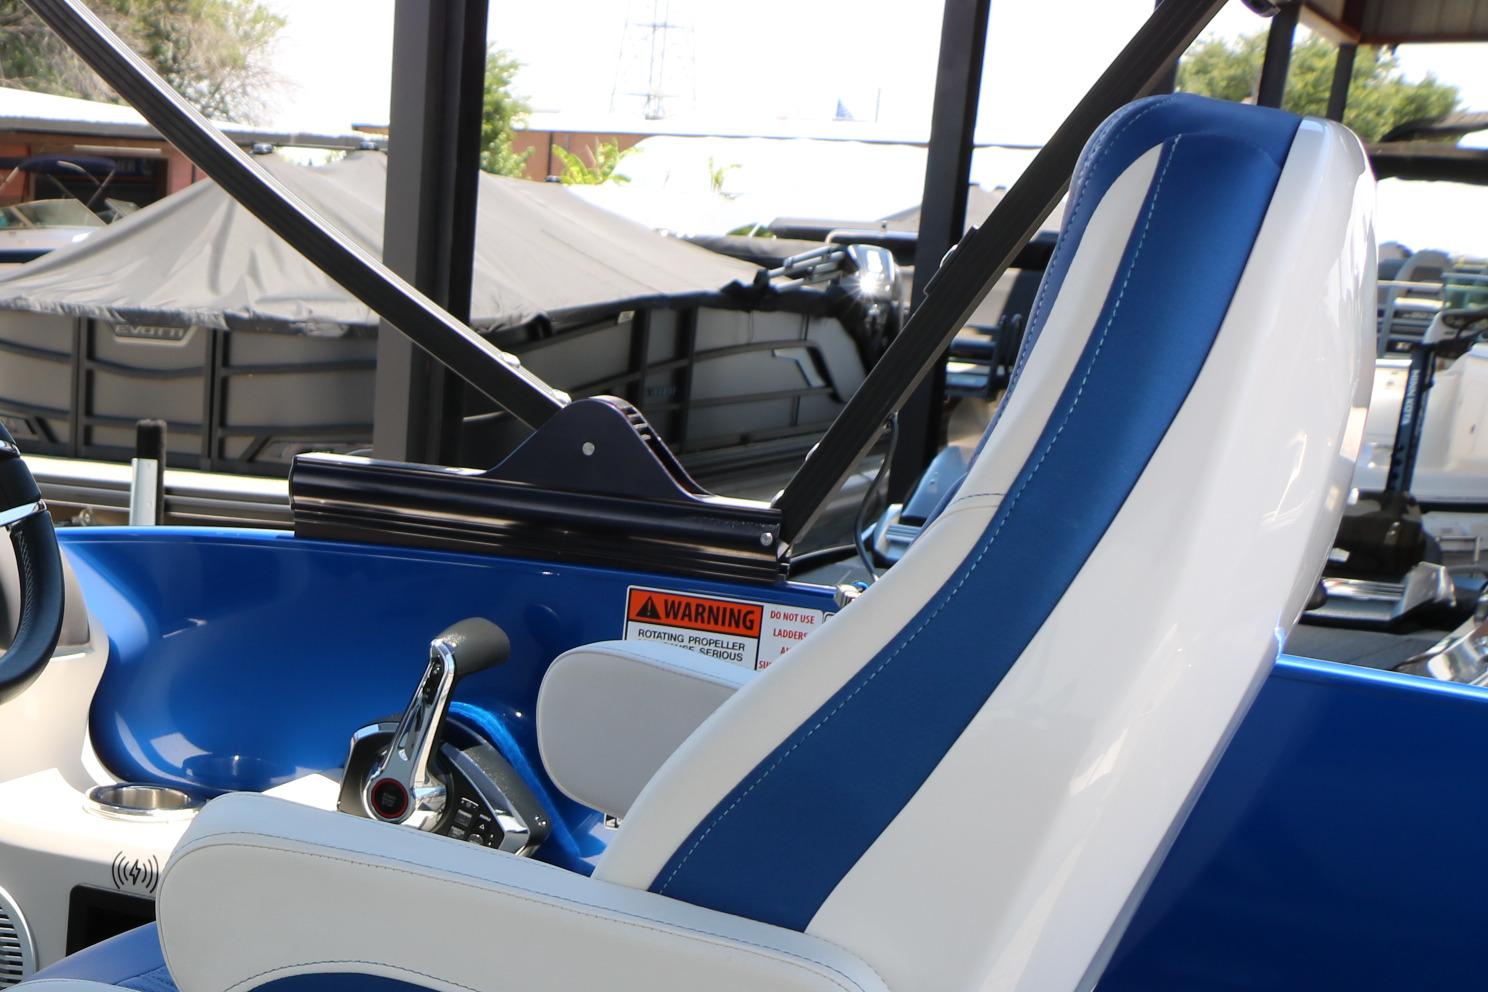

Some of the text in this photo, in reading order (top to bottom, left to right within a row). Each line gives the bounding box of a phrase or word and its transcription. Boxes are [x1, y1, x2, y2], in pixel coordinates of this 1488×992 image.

[1401, 369, 1421, 425] MINN KOTA
[663, 598, 755, 630] WARNING
[770, 610, 815, 625] DO NOT USE
[638, 628, 685, 643] ROTATING
[688, 635, 745, 651] PROPELLER
[699, 647, 743, 662] SERIOUS
